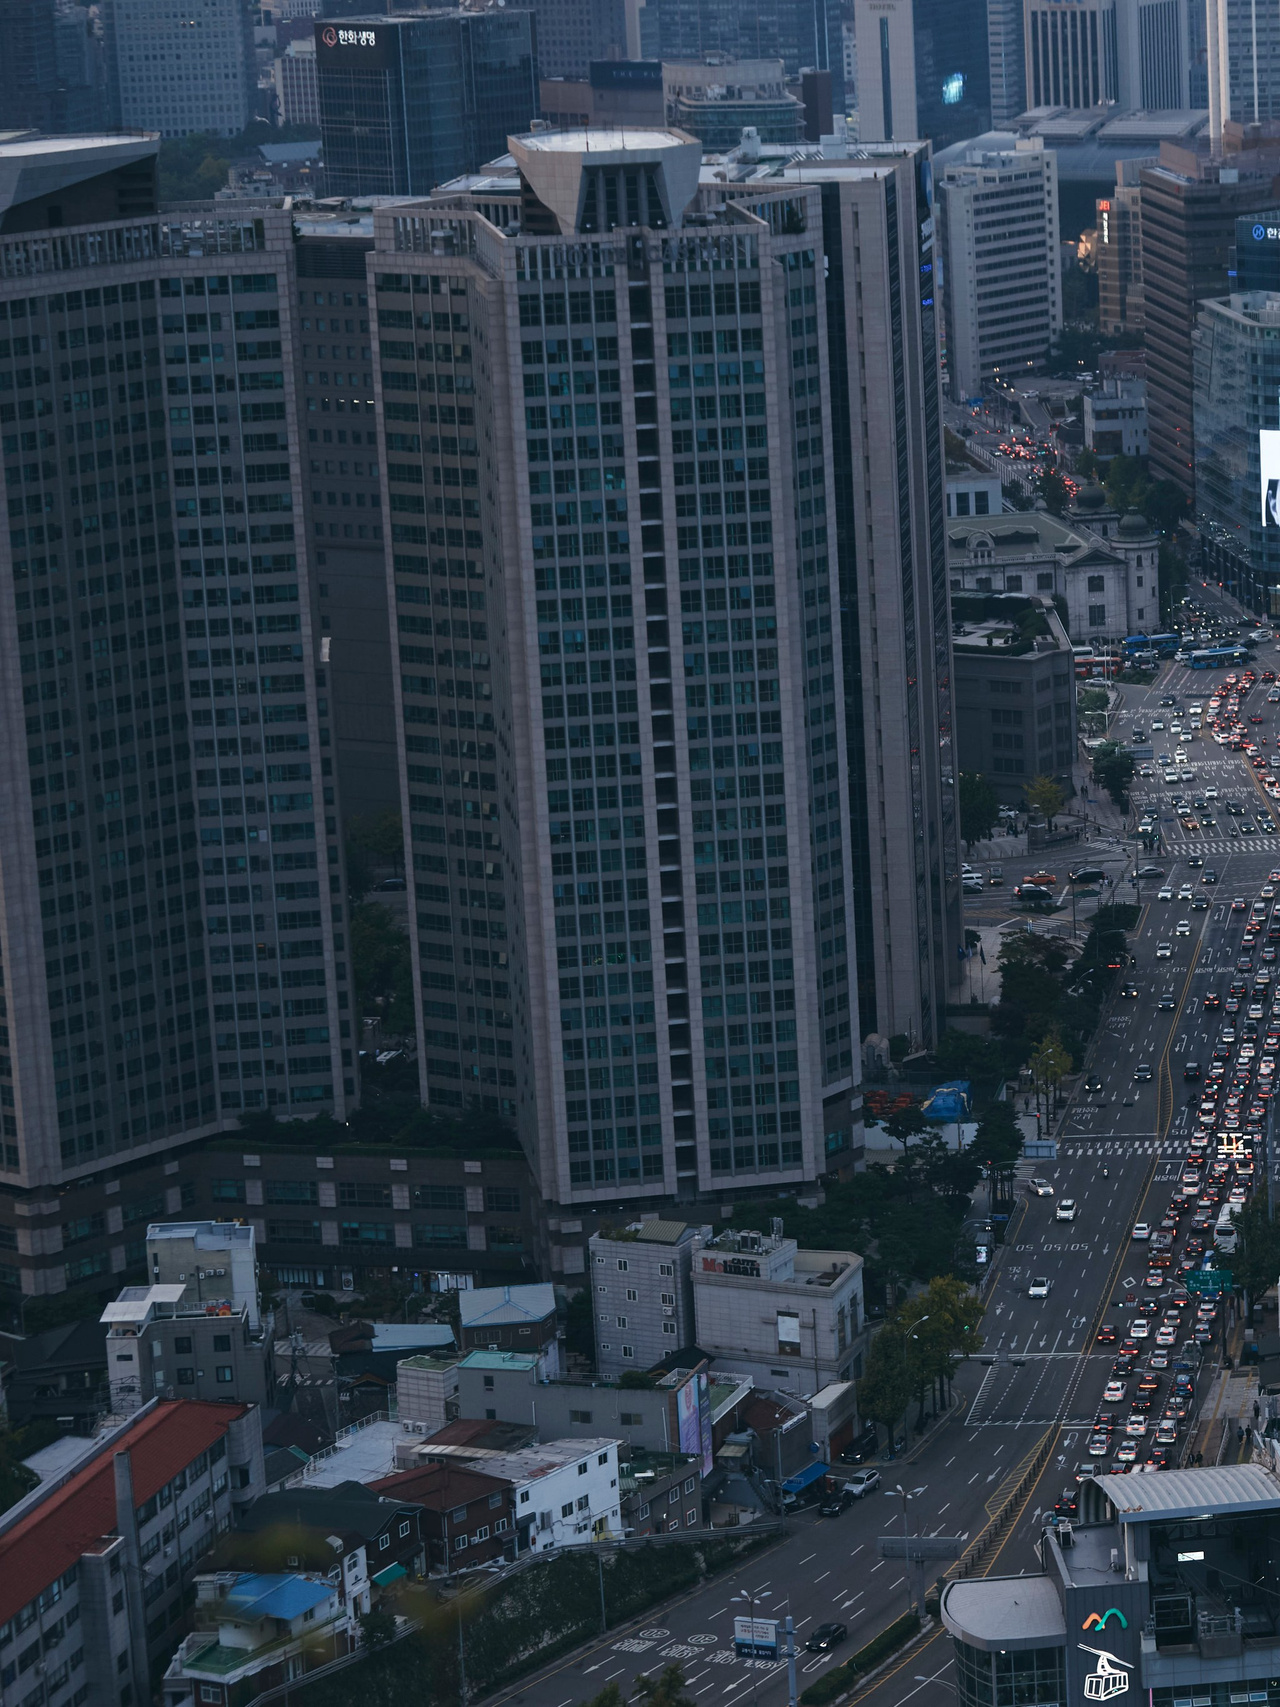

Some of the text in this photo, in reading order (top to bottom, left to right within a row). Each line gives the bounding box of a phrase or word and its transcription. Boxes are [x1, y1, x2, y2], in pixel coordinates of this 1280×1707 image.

[338, 29, 376, 47] 한화생명
[1099, 200, 1110, 211] JEI
[1043, 1243, 1062, 1251] 50
[1070, 1243, 1089, 1251] 50
